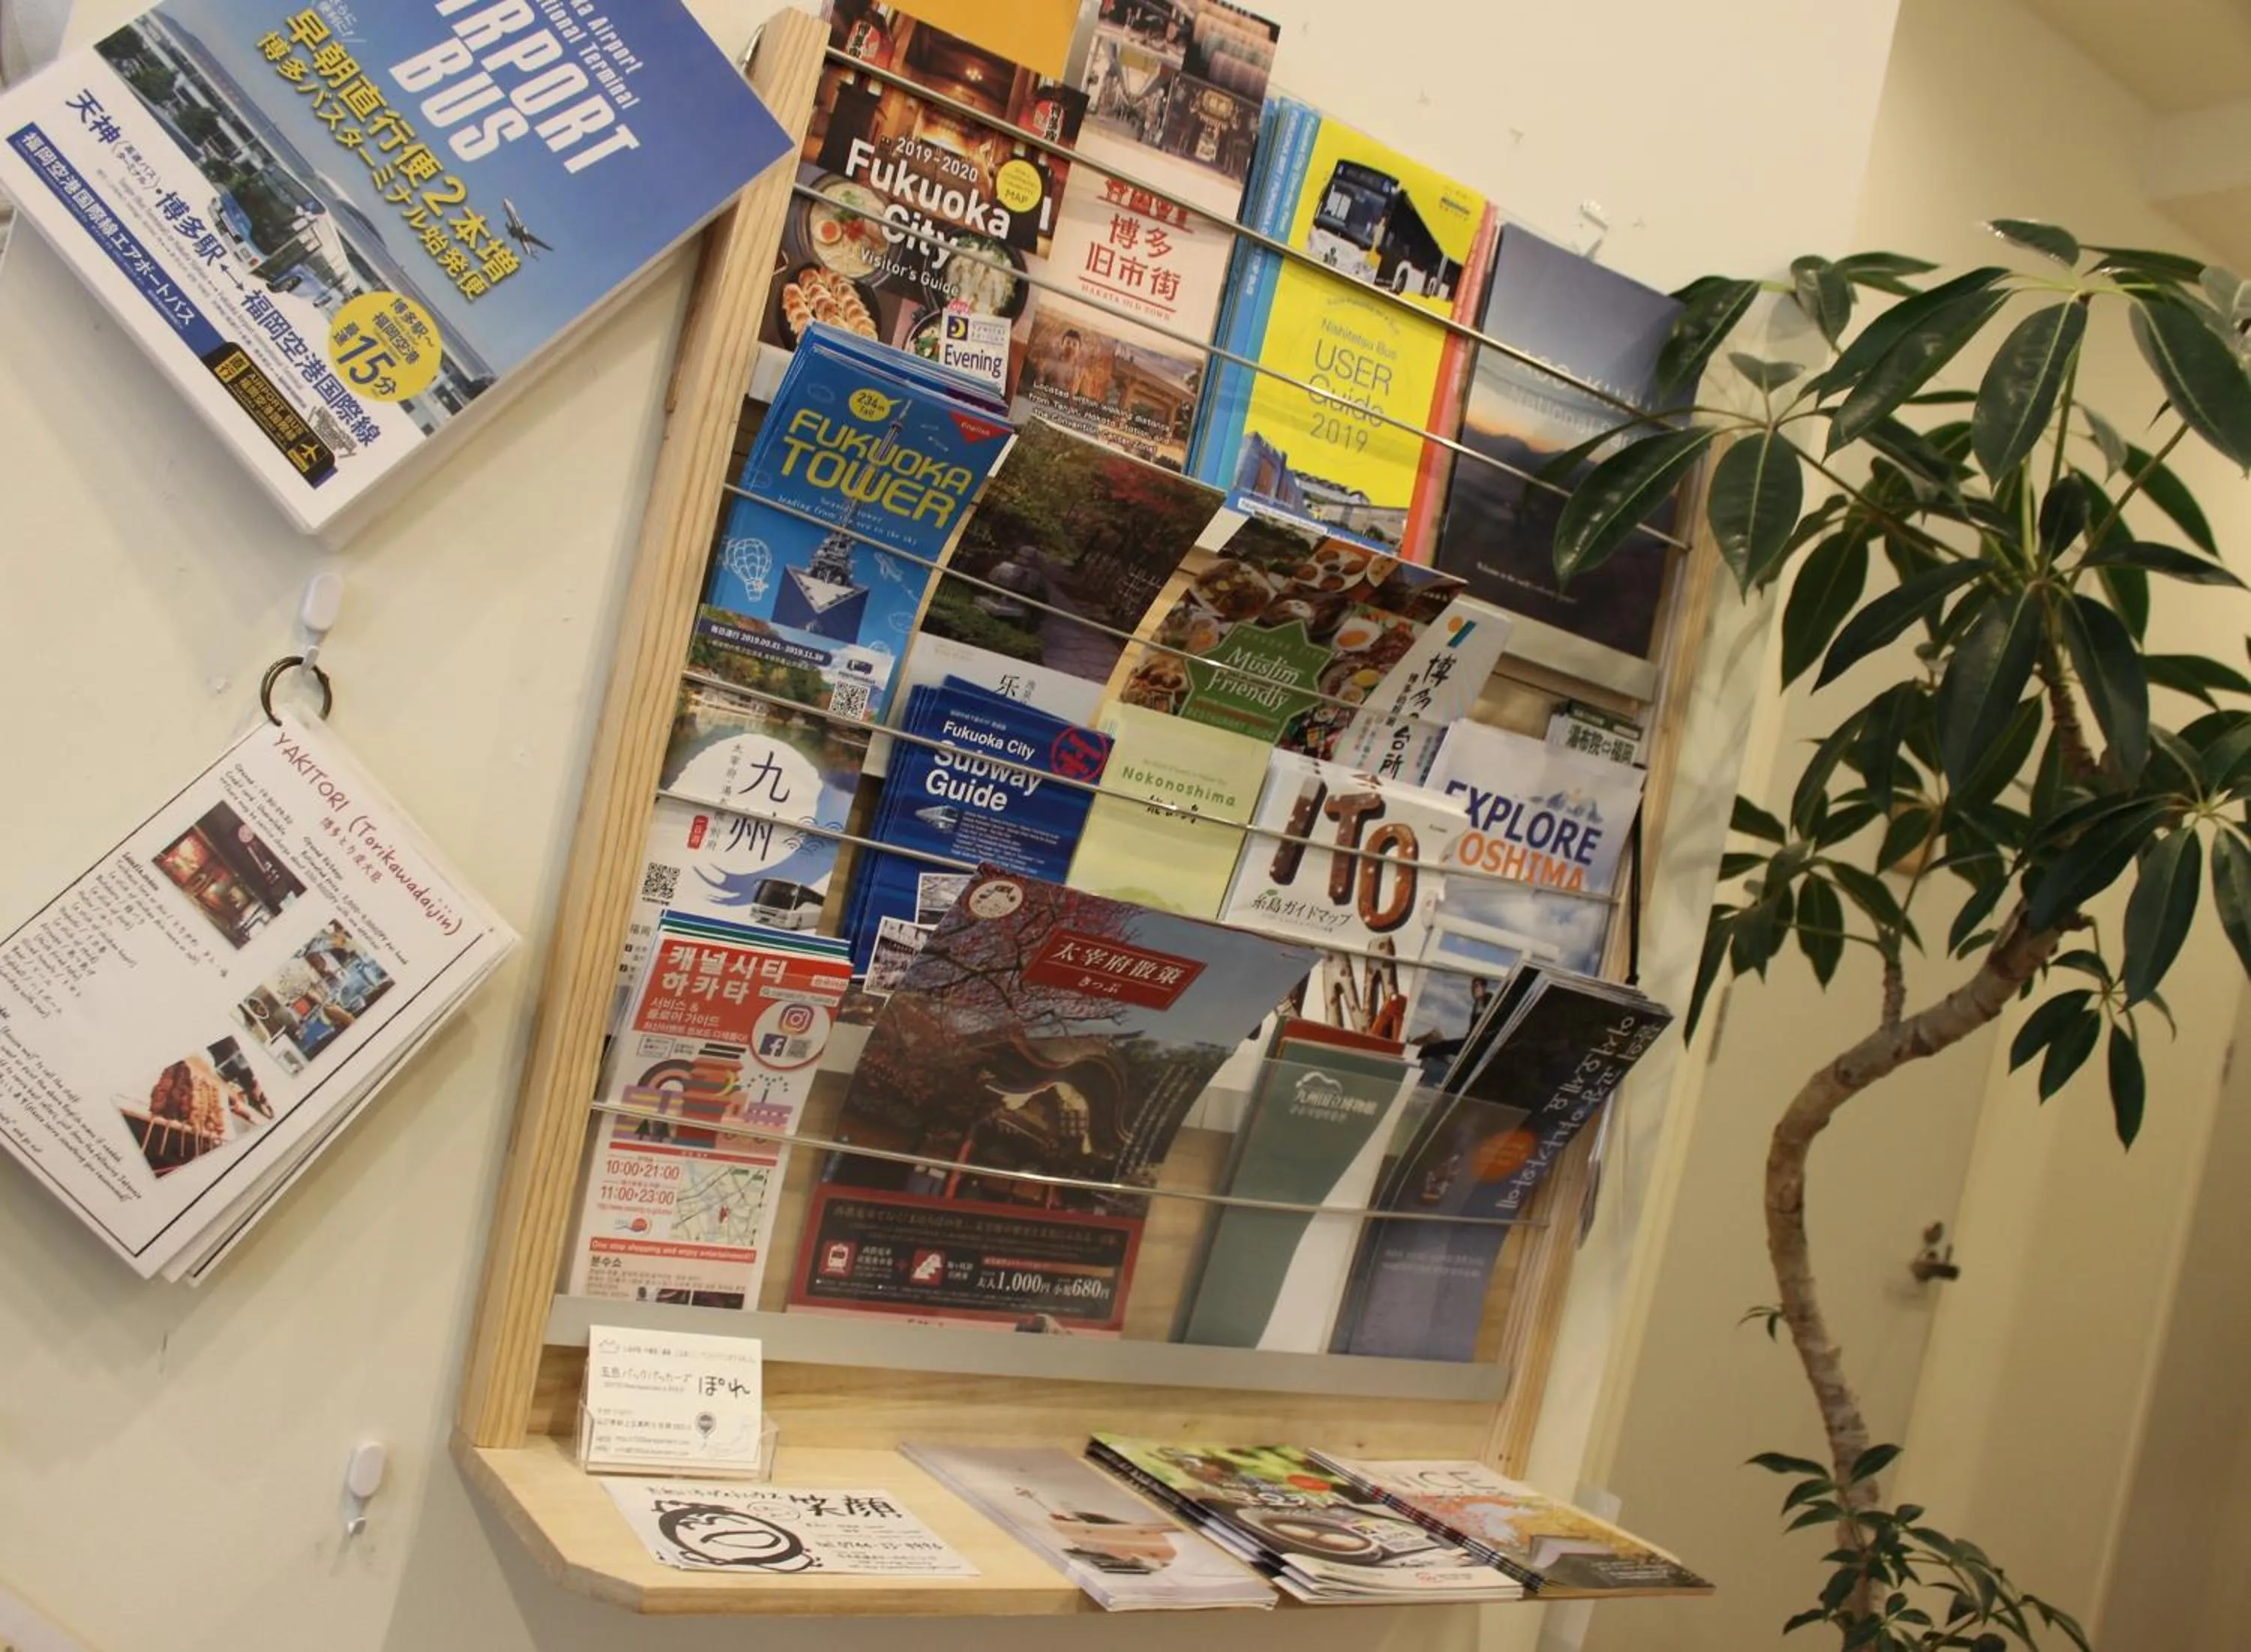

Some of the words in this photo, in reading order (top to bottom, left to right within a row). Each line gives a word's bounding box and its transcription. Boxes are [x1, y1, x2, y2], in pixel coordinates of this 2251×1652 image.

[588, 17, 643, 74] Airport
[578, 42, 640, 110] Terminal
[389, 37, 529, 162] BUS
[257, 29, 490, 300] 博多バスターミナル始発便
[287, 8, 521, 283] 早朝直行便2本増
[896, 137, 978, 182] 2019-2020
[845, 138, 1011, 240] Fukuoka
[23, 131, 195, 325] 福岡空港国際線エアポートバス
[882, 203, 958, 269] City
[1109, 213, 1174, 258] 博多
[65, 89, 121, 145] 天神
[155, 191, 226, 266] 博多駅
[240, 289, 381, 446] 福岡空港国際線
[862, 249, 916, 282] Visitor's
[921, 272, 960, 296] Guide
[1086, 242, 1182, 301] 旧市街
[1081, 284, 1119, 303] HAKATA
[1144, 305, 1171, 320] TOWN
[945, 344, 1002, 378] Evening
[1321, 317, 1373, 354] Nishitetsu
[1376, 339, 1397, 360] Bus
[1315, 338, 1393, 395] USER
[245, 371, 286, 416] AIRPORT
[283, 413, 305, 437] BUS
[1027, 392, 1050, 406] from
[1083, 411, 1116, 427] Hakata
[1153, 434, 1171, 444] and
[1031, 380, 1069, 398] Located
[1071, 394, 1100, 409] within
[1101, 404, 1133, 420] walking
[1033, 408, 1048, 419] the
[1050, 413, 1099, 435] Convention
[1308, 374, 1384, 427] Guide
[789, 408, 972, 495] FUKUOKA
[1309, 412, 1368, 454] 2019
[780, 436, 956, 529] TOWER
[1225, 647, 1300, 686] Muslim
[1207, 670, 1291, 711] Friendly
[943, 720, 1004, 749] Fukuoka
[1007, 735, 1035, 760] City
[924, 768, 1008, 812] Guide
[933, 739, 1042, 797] Subway
[1122, 767, 1236, 807] Nokonoshima
[272, 732, 349, 812] YAKITORI
[347, 815, 464, 937] (Torikawadaijin)
[1459, 830, 1586, 892] OSHIMA
[667, 945, 788, 984] 캐널시티
[1054, 940, 1185, 984] 太宰府散策
[650, 996, 687, 1012] 서비스
[662, 974, 750, 1003] 하카타
[683, 1011, 721, 1028] 가이드
[606, 1160, 639, 1176] 10:00
[644, 1162, 681, 1181] 21:00
[600, 1185, 634, 1202] 11:00
[639, 1188, 675, 1205] 23:00
[628, 1245, 663, 1257] shopping
[679, 1249, 699, 1261] enjoy
[698, 1375, 750, 1396] ぽれ
[792, 1493, 903, 1518] 笑顔
